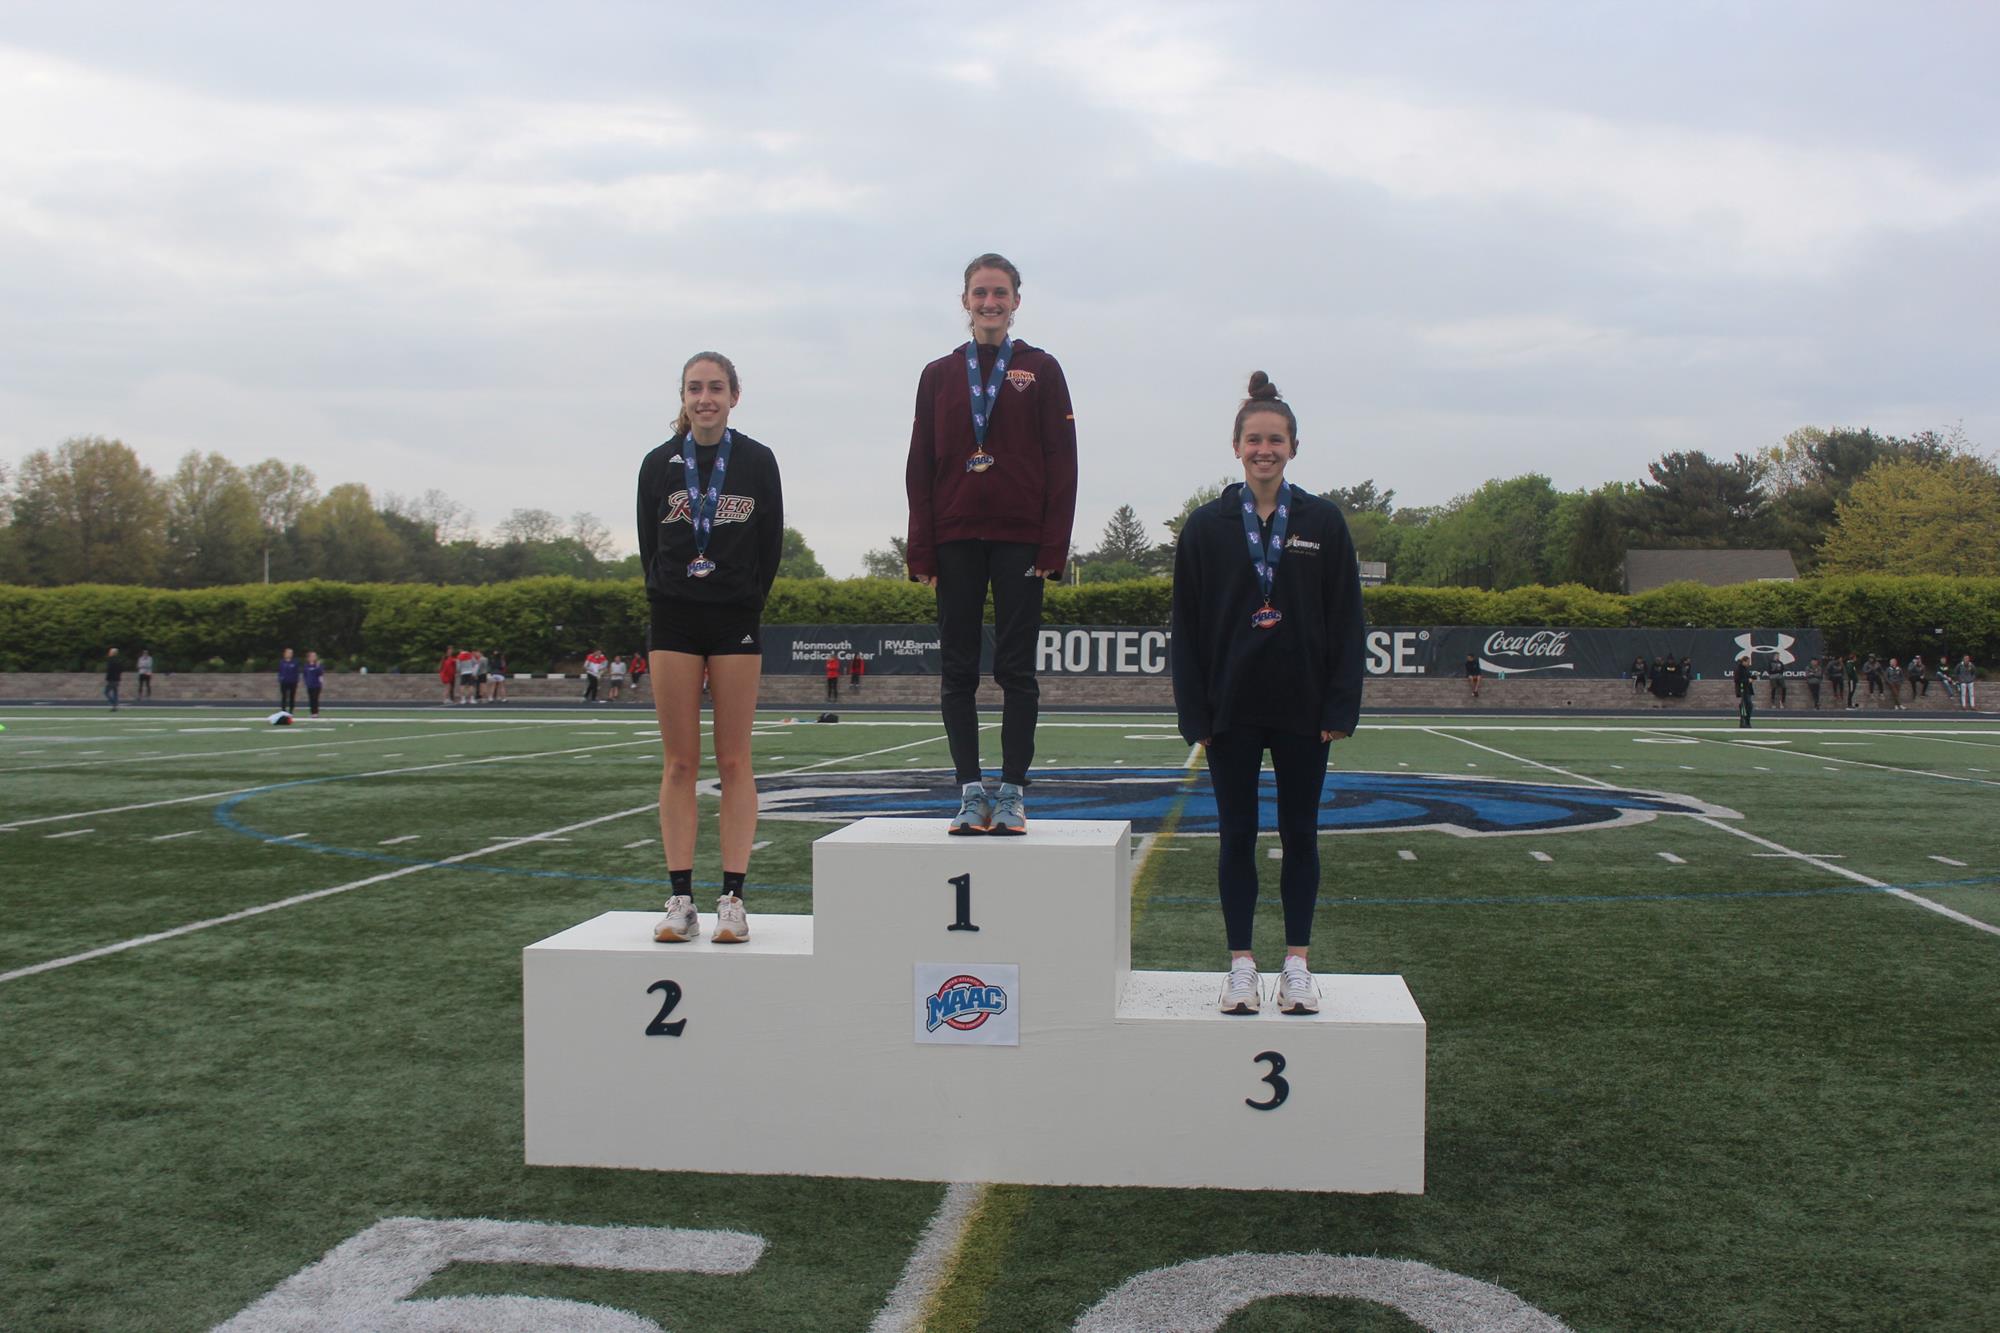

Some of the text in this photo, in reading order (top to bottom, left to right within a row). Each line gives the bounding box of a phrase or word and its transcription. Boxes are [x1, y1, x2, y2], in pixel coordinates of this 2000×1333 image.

[662, 490, 755, 526] RDER
[792, 640, 852, 650] Monmouth
[1035, 629, 1171, 673] ROTEC
[947, 873, 980, 931] 1
[644, 979, 687, 1038] 2
[926, 985, 1007, 1033] MAAC
[1244, 1050, 1291, 1110] 3
